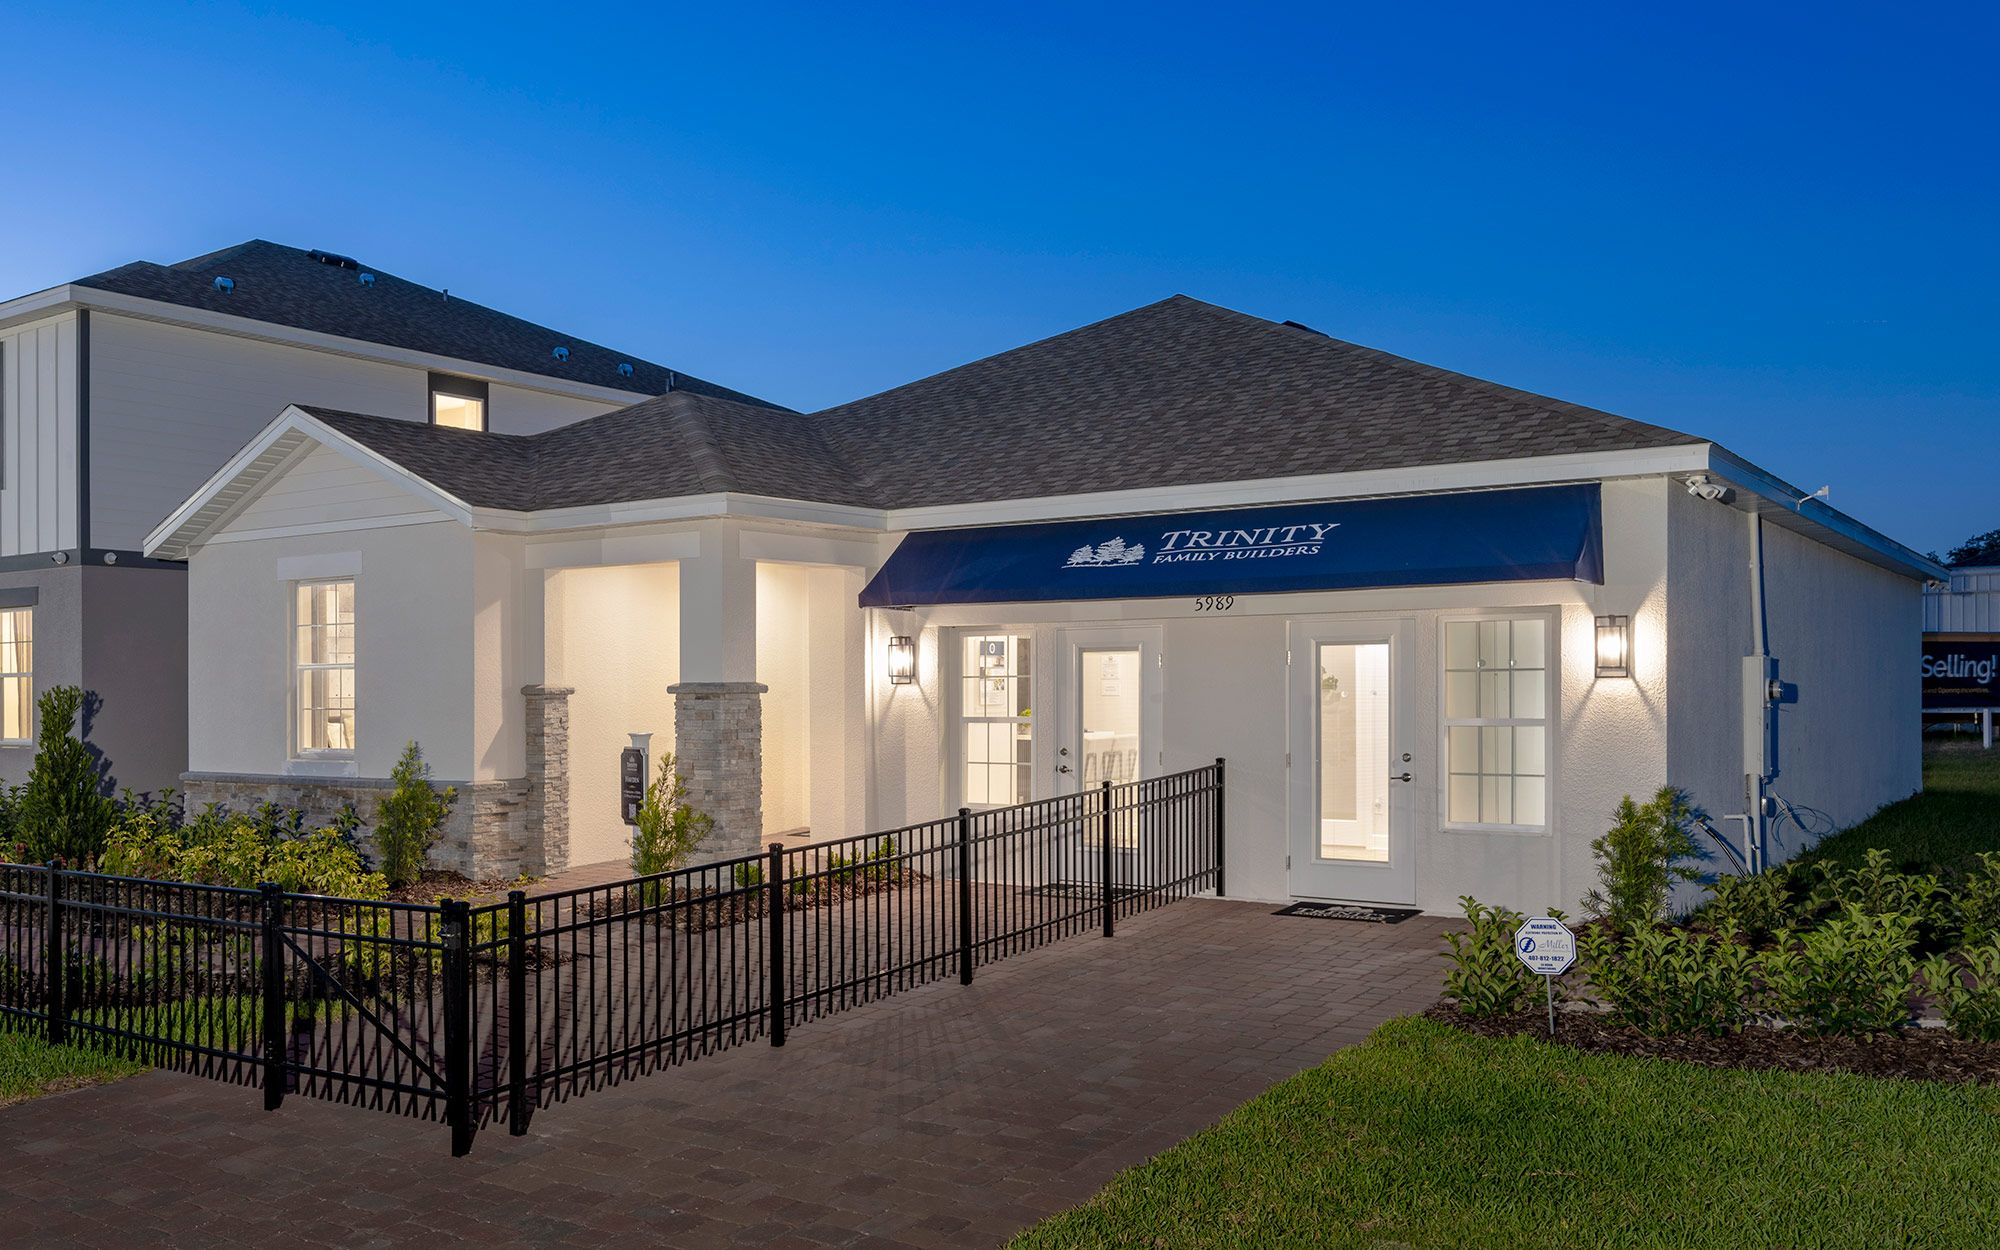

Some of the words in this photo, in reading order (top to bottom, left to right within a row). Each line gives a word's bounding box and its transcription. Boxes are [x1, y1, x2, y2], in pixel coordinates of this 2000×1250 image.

[1160, 523, 1340, 550] TRINITY
[1152, 551, 1220, 565] FAMILY
[1224, 545, 1323, 561] BUILDERS
[1194, 595, 1234, 612] 5989
[1921, 654, 1996, 684] Selling!
